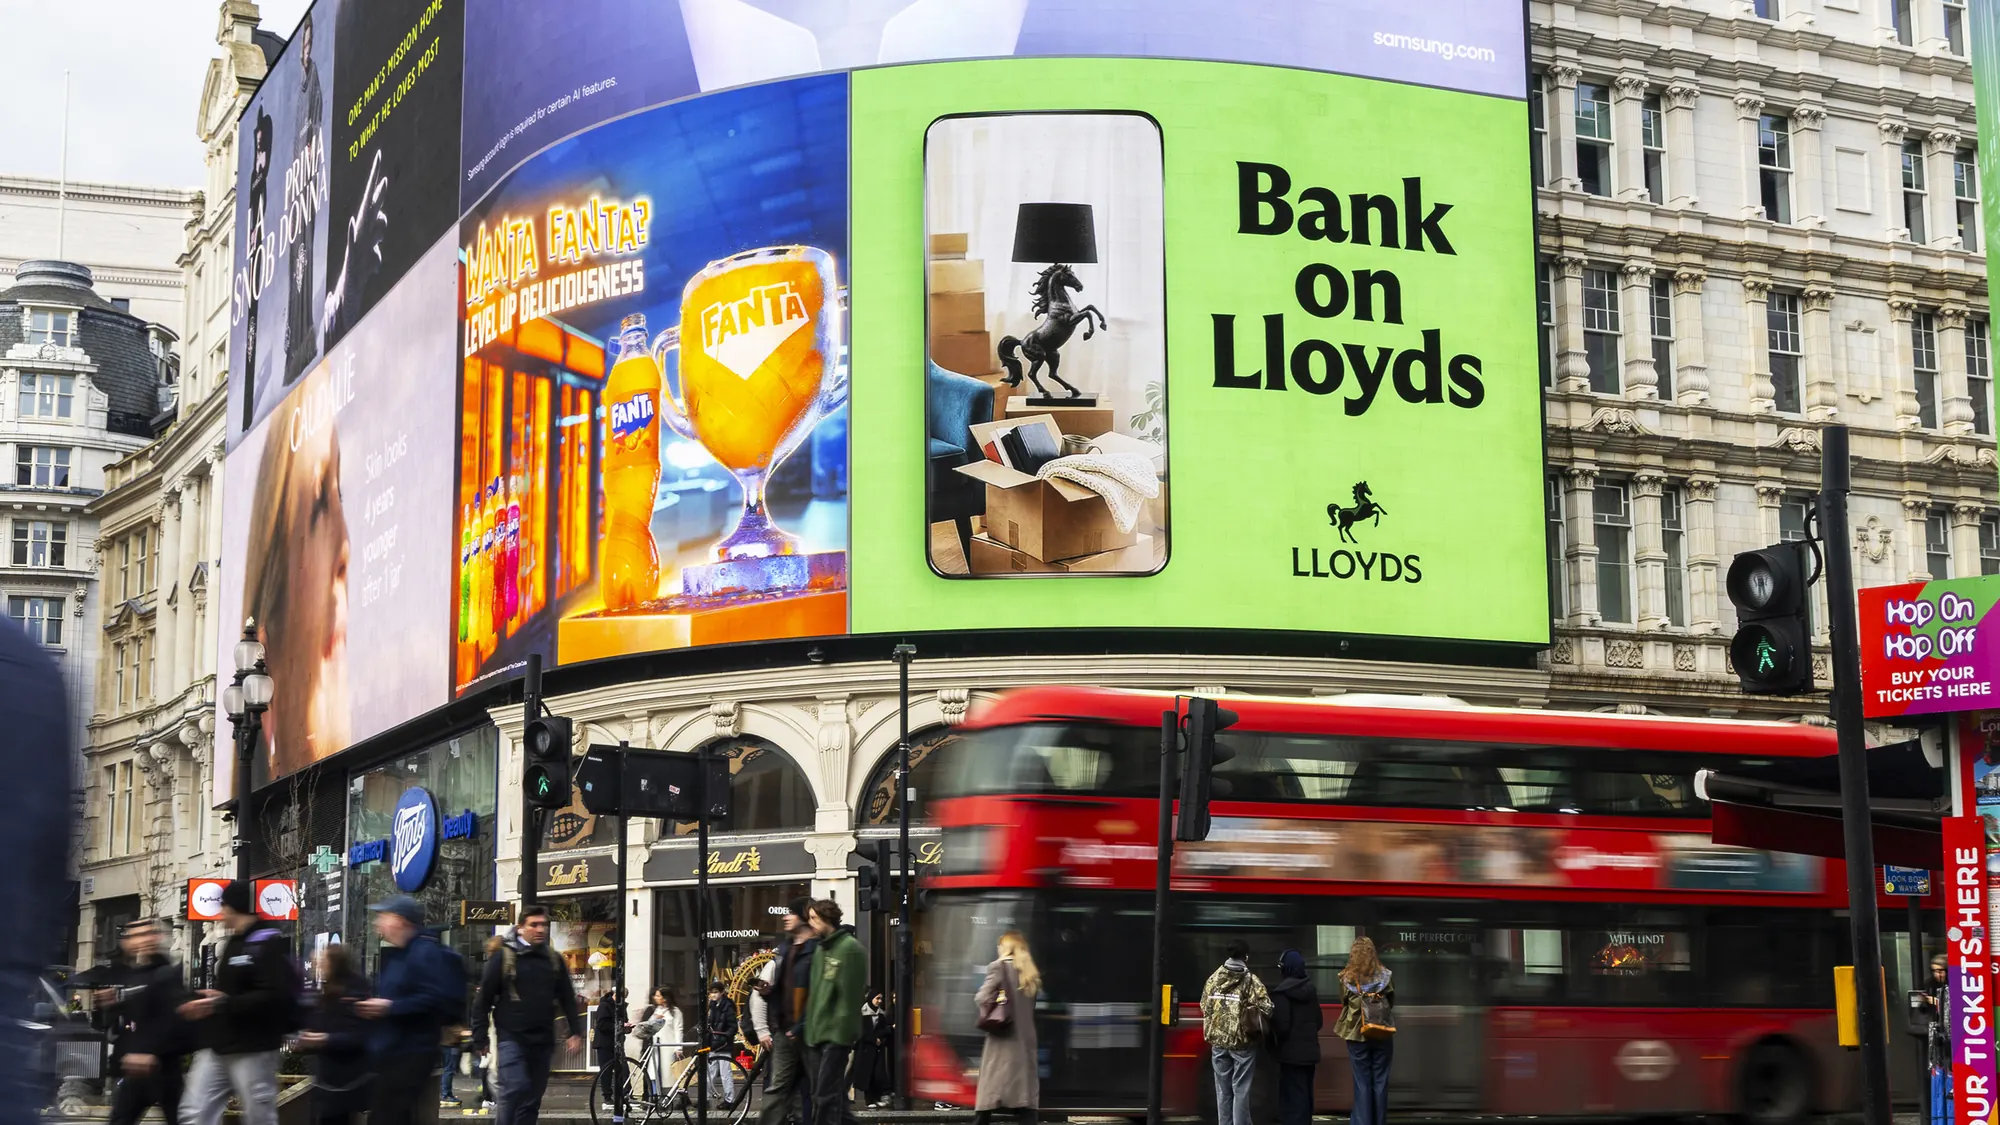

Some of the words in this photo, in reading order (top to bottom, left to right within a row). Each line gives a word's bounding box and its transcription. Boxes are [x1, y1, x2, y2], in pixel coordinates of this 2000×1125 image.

[348, 97, 362, 126] ONE
[364, 66, 386, 107] MAN'S
[387, 24, 418, 76] MISSION
[420, 0, 443, 33] HOME
[1373, 31, 1495, 62] samsung.com
[349, 140, 358, 162] TO
[360, 112, 380, 148] WHAT
[381, 98, 391, 122] HE
[393, 66, 416, 108] LOVES
[418, 36, 440, 77] MOST
[467, 159, 485, 181] Samsung
[484, 143, 500, 165] account
[509, 128, 514, 139] is
[514, 111, 537, 136] required
[537, 107, 547, 121] for
[546, 94, 571, 115] certain
[582, 76, 618, 97] features.
[284, 127, 325, 211] PRIMA
[246, 193, 265, 260] LA
[278, 164, 328, 259] DONNA
[1235, 161, 1458, 256] Bank
[465, 219, 538, 305] WANTA
[548, 196, 651, 264] FANTA?
[232, 231, 275, 327] SNOB
[1295, 262, 1404, 325] on
[464, 302, 498, 358] LEVEL
[500, 292, 517, 334] UP
[519, 259, 645, 325] DELICIOUSNESS
[702, 285, 807, 350] FANTA
[1210, 313, 1485, 417] Lloyds
[611, 393, 655, 430] FANTA
[365, 451, 383, 484] Skin
[384, 430, 407, 470] looks
[364, 493, 371, 523] 4
[371, 485, 395, 528] years
[362, 524, 398, 573] younger
[1292, 547, 1422, 583] LLOYDS
[361, 574, 383, 608] after
[1940, 593, 1973, 621] On
[1938, 628, 1977, 655] Off
[1876, 686, 1943, 703] TICKETS
[1947, 682, 1992, 697] HERE
[1891, 670, 1925, 685] BUY
[1928, 666, 1975, 682] YOUR
[393, 801, 427, 874] Boots
[443, 809, 473, 839] beauty
[545, 863, 580, 887] Lindt
[1887, 875, 1907, 883] LOOK
[1955, 847, 1982, 927] HERE
[467, 907, 500, 920] Lindt
[707, 929, 760, 939] #LINDTLONDON
[1398, 932, 1417, 941] THE
[1419, 932, 1456, 942] PERFECT
[1609, 934, 1635, 944] WITH
[1637, 934, 1665, 944] LINDT
[1959, 938, 1988, 1066] TICKETS
